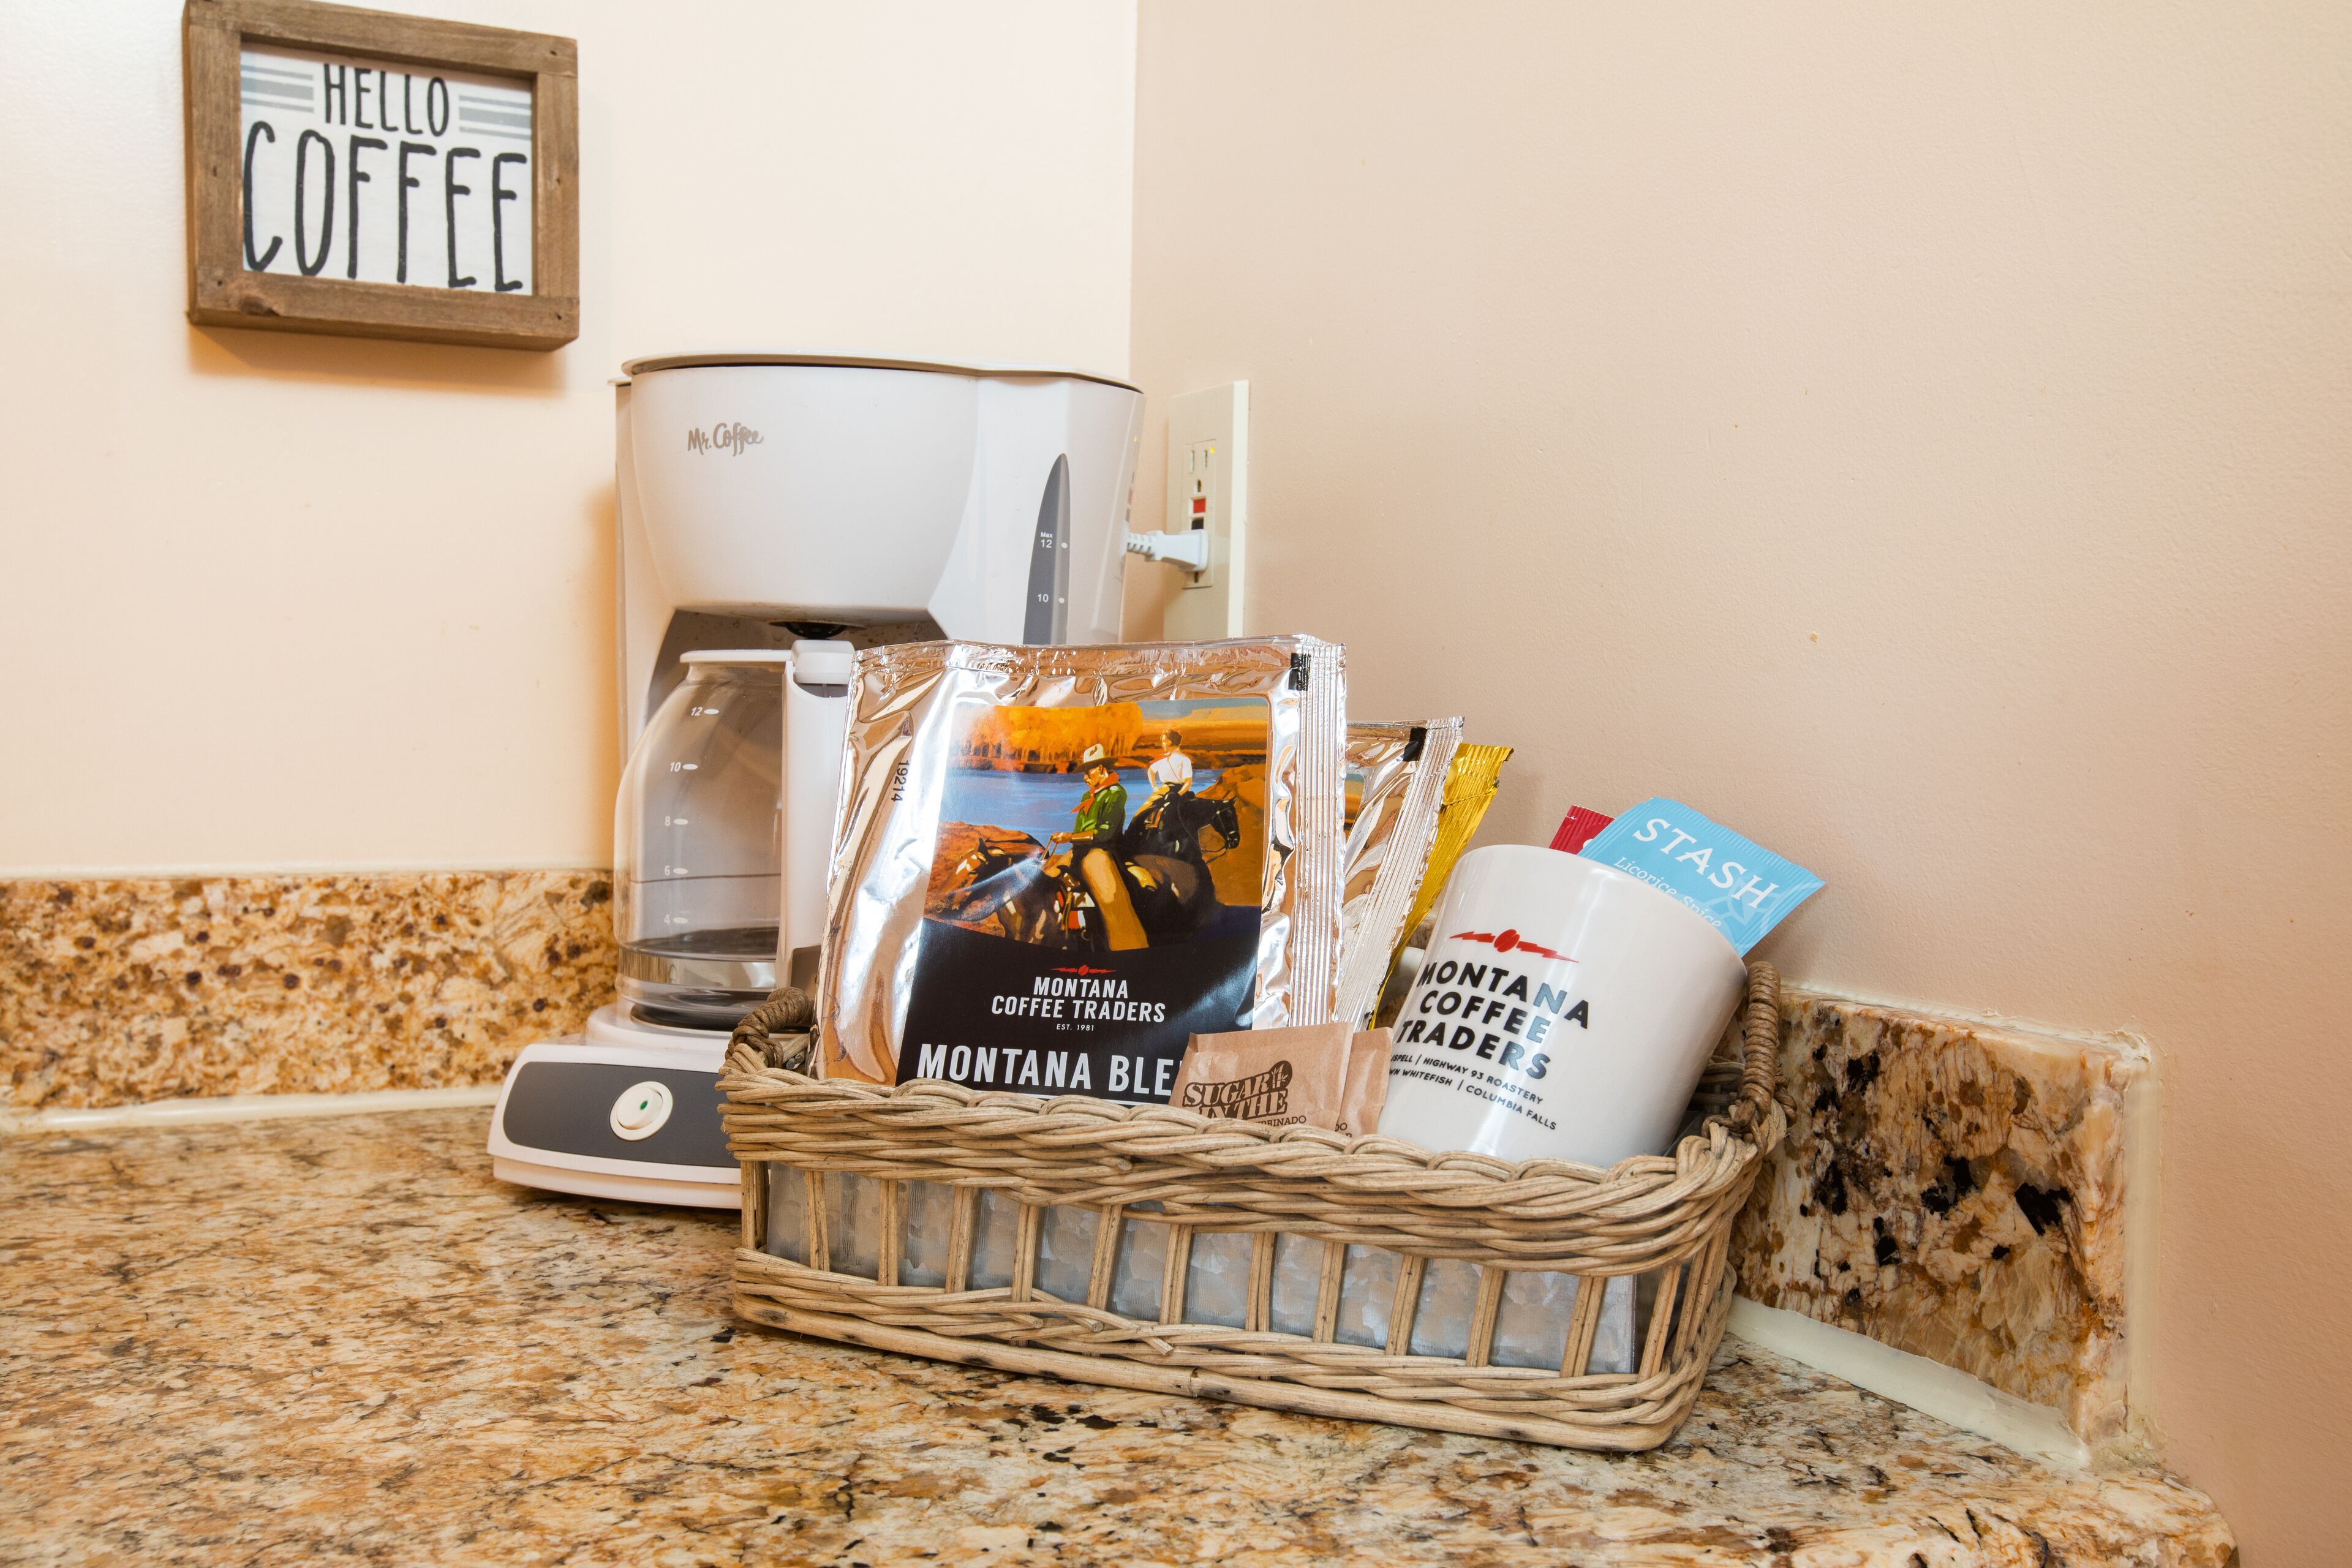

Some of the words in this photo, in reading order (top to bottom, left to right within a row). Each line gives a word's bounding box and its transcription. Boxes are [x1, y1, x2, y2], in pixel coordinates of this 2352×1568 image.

[323, 63, 450, 137] HELLO
[243, 121, 527, 292] COFFEE
[687, 428, 712, 456] Mr.
[712, 421, 764, 457] Coffee
[1041, 539, 1053, 549] 12
[1037, 593, 1049, 603] 10
[690, 706, 703, 717] 12
[669, 761, 681, 772] 10
[891, 760, 911, 802] 19214
[664, 816, 671, 826] 8
[664, 865, 671, 876] 6
[1613, 856, 1678, 895] Licorice
[1632, 817, 1779, 909] STASH
[663, 914, 671, 925] 4
[1033, 976, 1129, 999] MONTANA
[1416, 960, 1589, 1030] MONTANA
[991, 995, 1065, 1019] COFFEE
[1072, 1000, 1166, 1023] TRADERS
[1419, 990, 1551, 1044] COFFEE
[1396, 1020, 1551, 1080] TRADERS
[916, 1043, 1092, 1090] MONTANA
[1107, 1055, 1182, 1096] BLE
[1390, 1054, 1413, 1063] ISPELL
[1423, 1057, 1469, 1074] HIGHWAY
[1471, 1070, 1484, 1080] 93
[1487, 1076, 1544, 1104] ROASTERY
[1184, 1072, 1272, 1106] SUGAR
[1233, 1089, 1287, 1120] THE
[1402, 1069, 1453, 1086] WHITEFISH
[1466, 1085, 1523, 1114] COLUMBIA
[1526, 1109, 1557, 1130] FALLS
